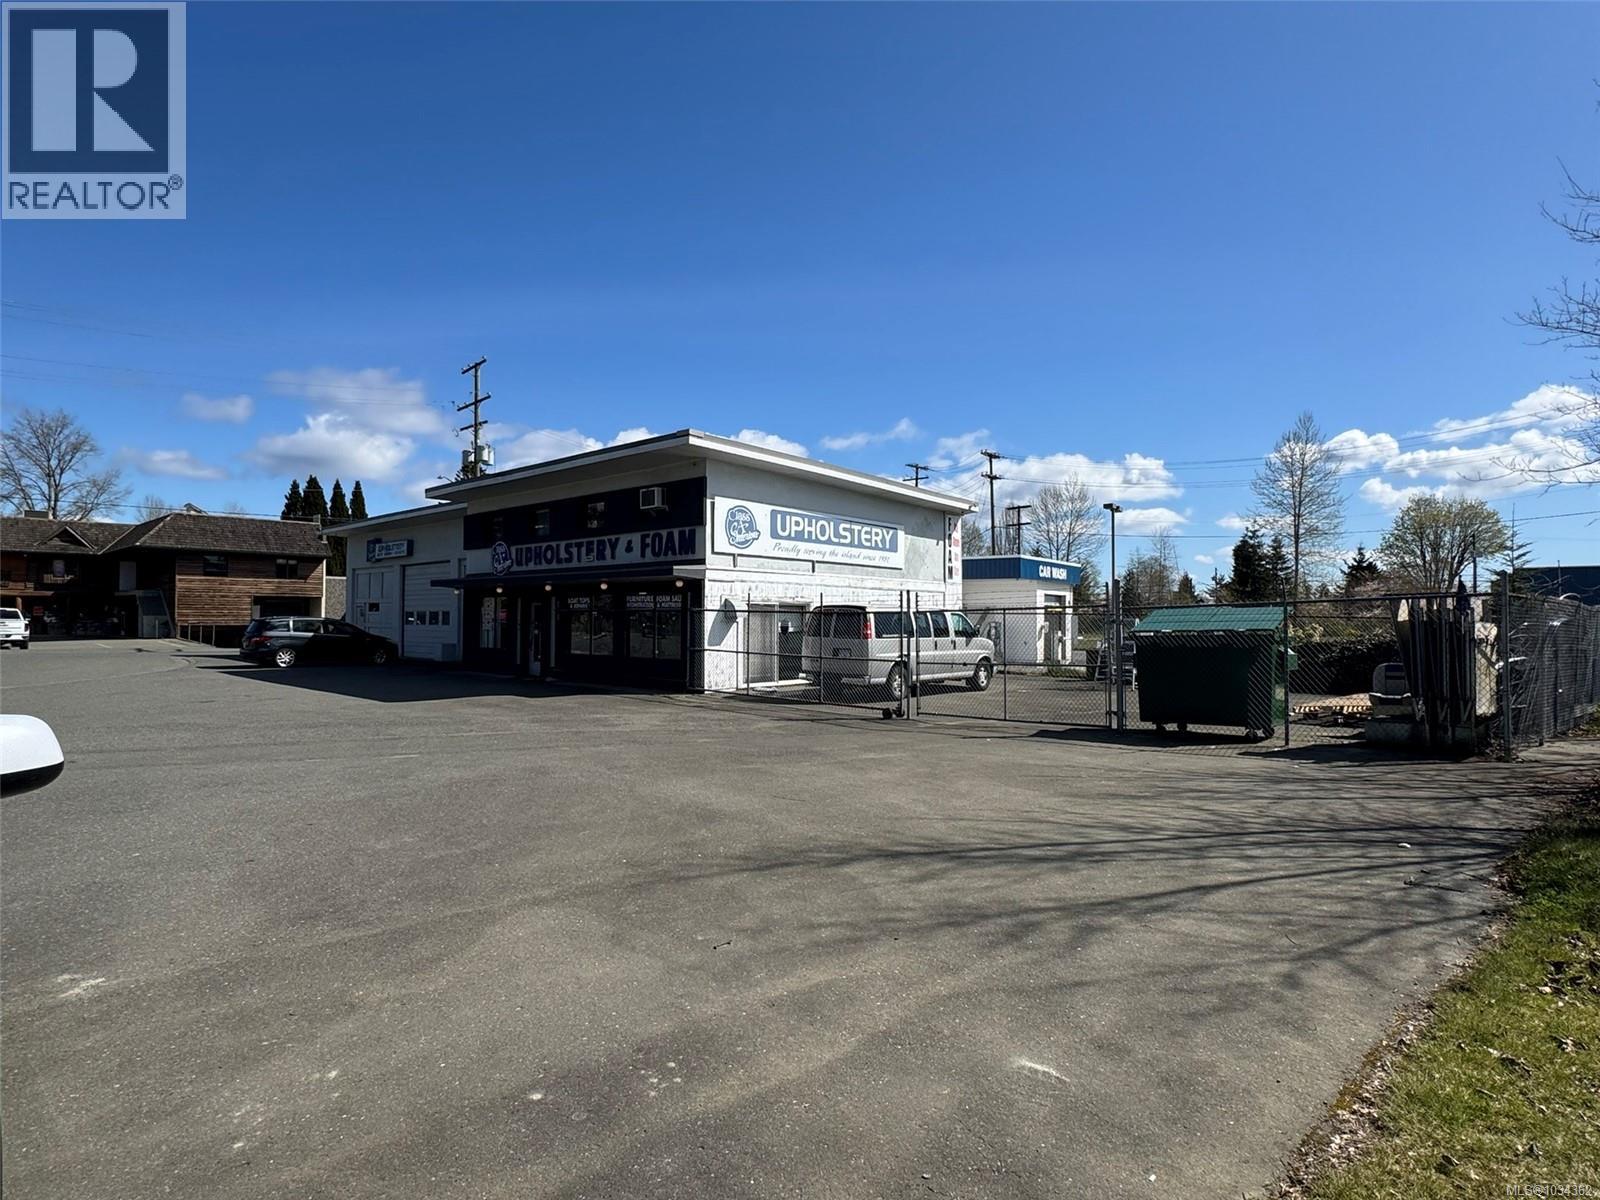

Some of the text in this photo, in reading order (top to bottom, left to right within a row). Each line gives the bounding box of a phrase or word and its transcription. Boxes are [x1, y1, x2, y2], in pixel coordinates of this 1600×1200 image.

[777, 513, 894, 549] UPHOLSTERY
[514, 537, 620, 567] UPHOLSTERY
[625, 539, 634, 554] &
[640, 528, 697, 558] FOAM
[773, 542, 801, 557] Proudly
[829, 548, 839, 557] the
[1039, 565, 1067, 580] CAR WASH
